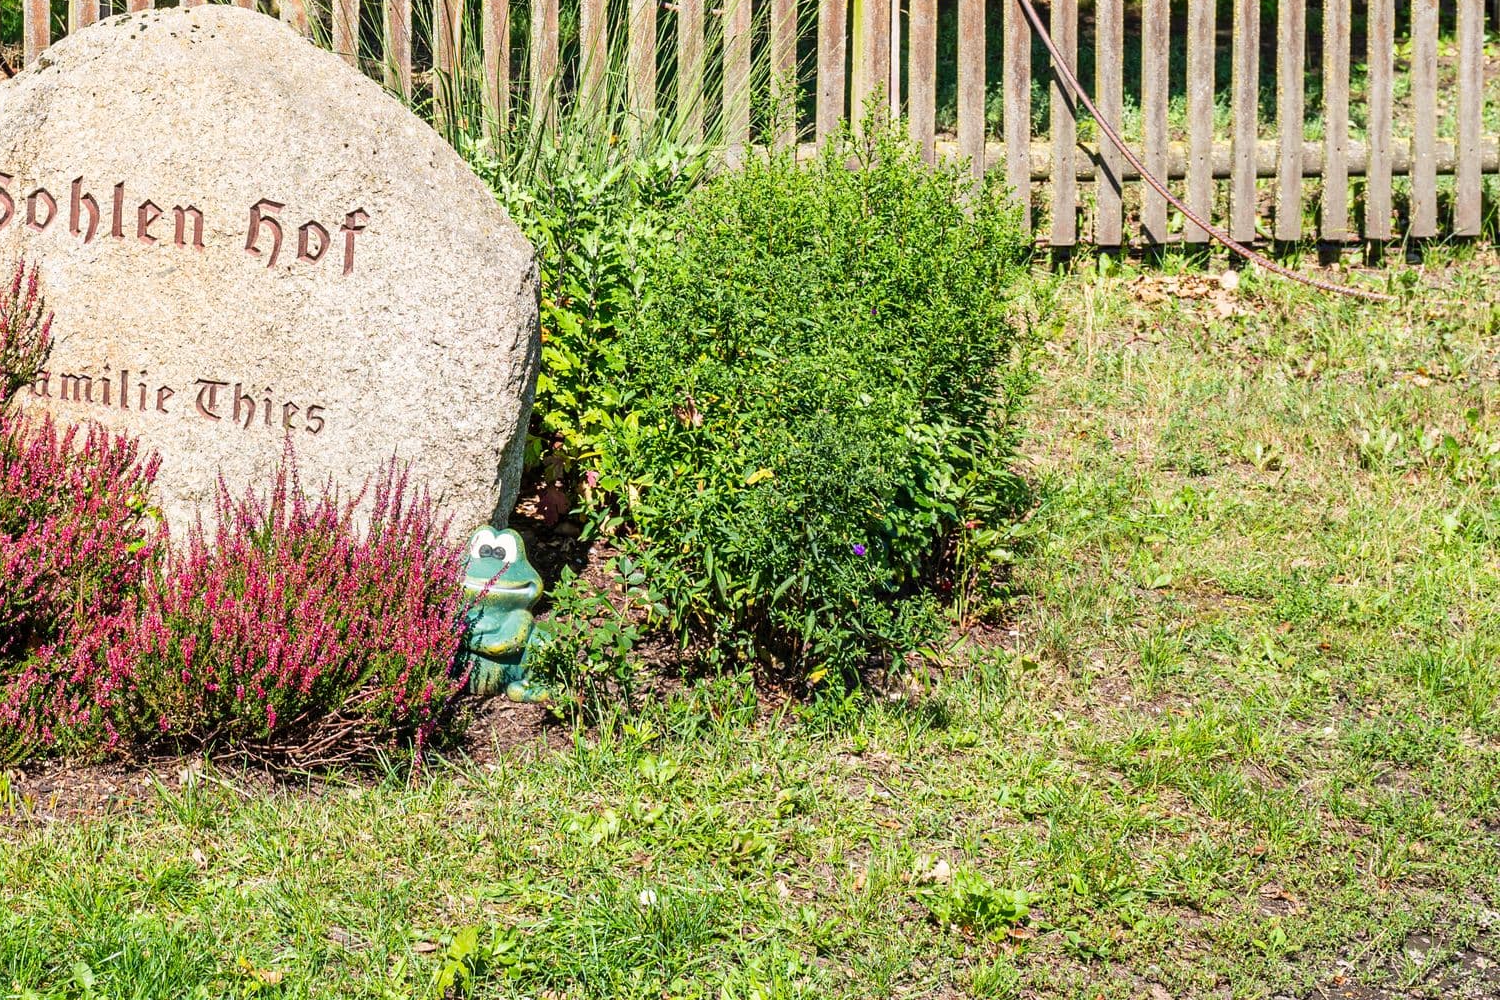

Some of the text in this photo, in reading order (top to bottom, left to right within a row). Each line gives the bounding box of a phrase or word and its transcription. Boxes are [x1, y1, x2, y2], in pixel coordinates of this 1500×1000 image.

[244, 197, 372, 277] Hof
[29, 364, 327, 436] amilie Thies
